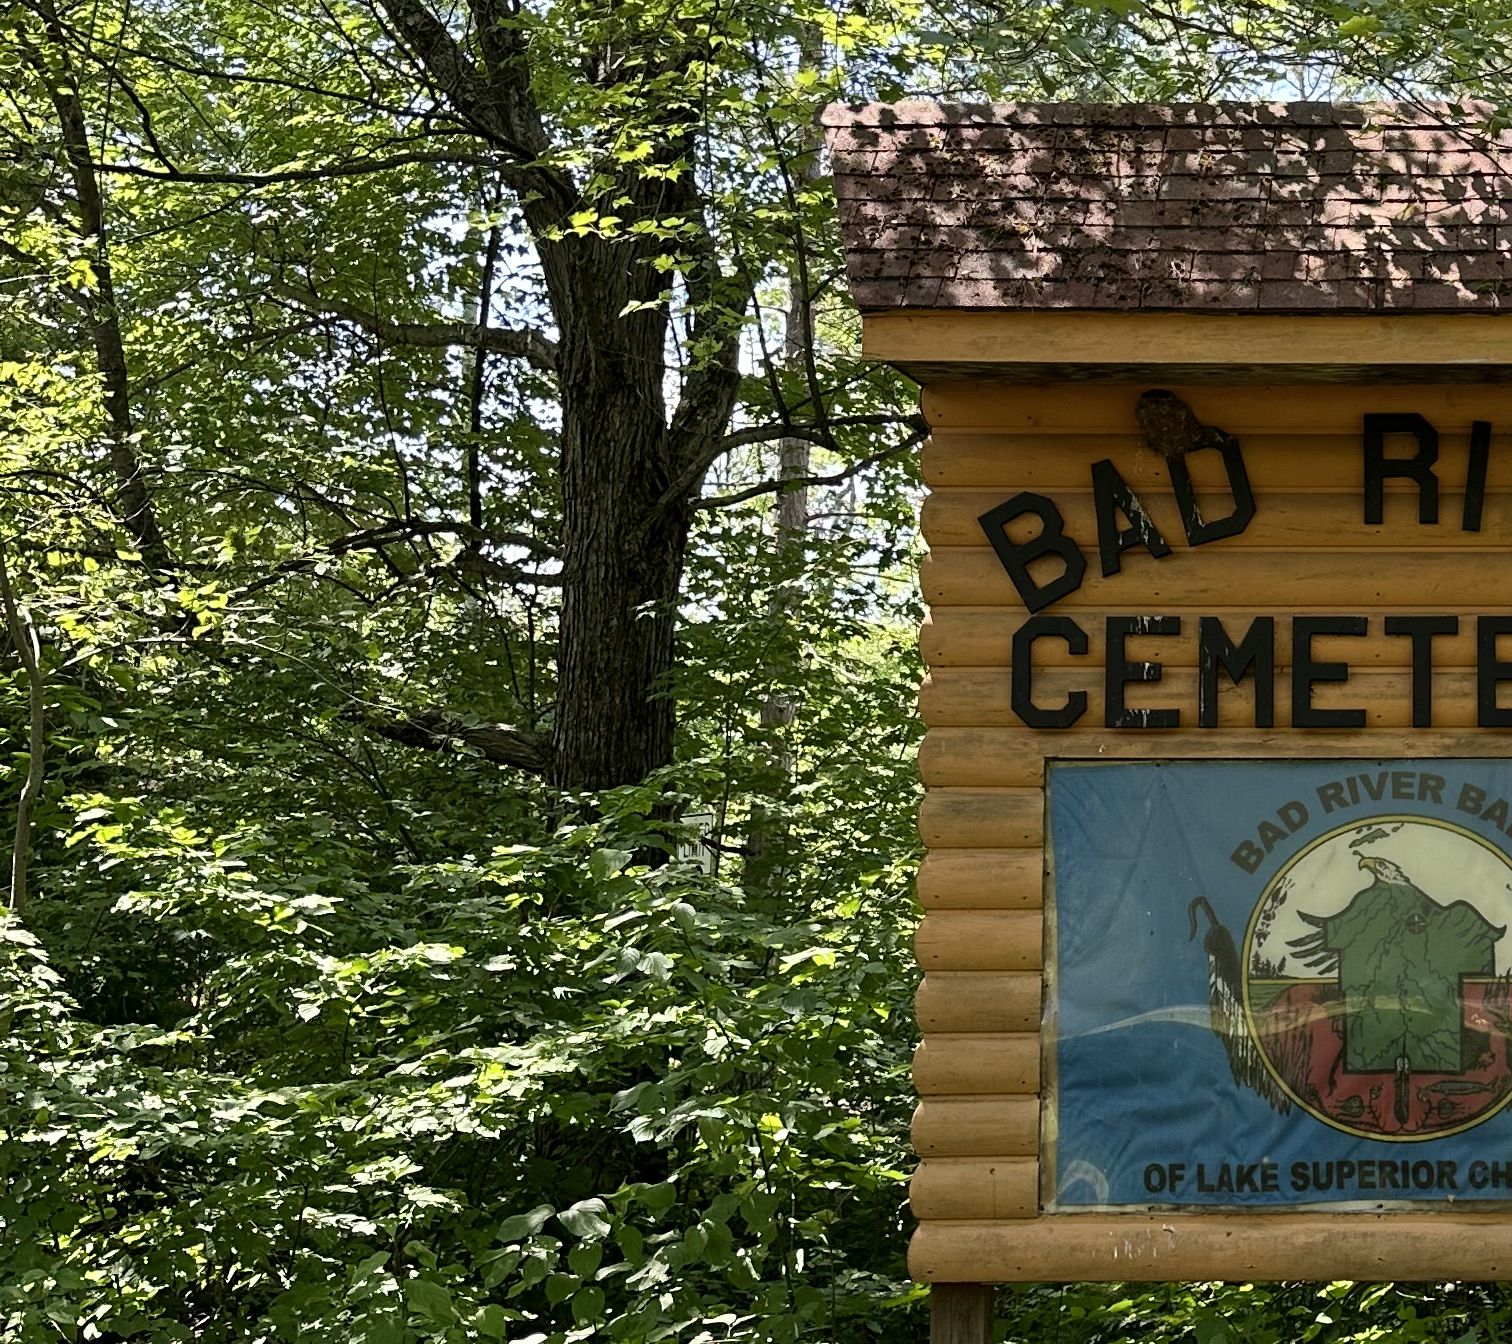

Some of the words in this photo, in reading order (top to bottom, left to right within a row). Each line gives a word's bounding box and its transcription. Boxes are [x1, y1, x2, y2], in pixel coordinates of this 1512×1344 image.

[977, 425, 1257, 615] BAD
[1230, 799, 1310, 875] BAD
[1315, 770, 1447, 814] RIVER
[1143, 1162, 1187, 1194] OF
[1199, 1161, 1280, 1193] LAKE
[1290, 1159, 1458, 1191] SUPERIOR
